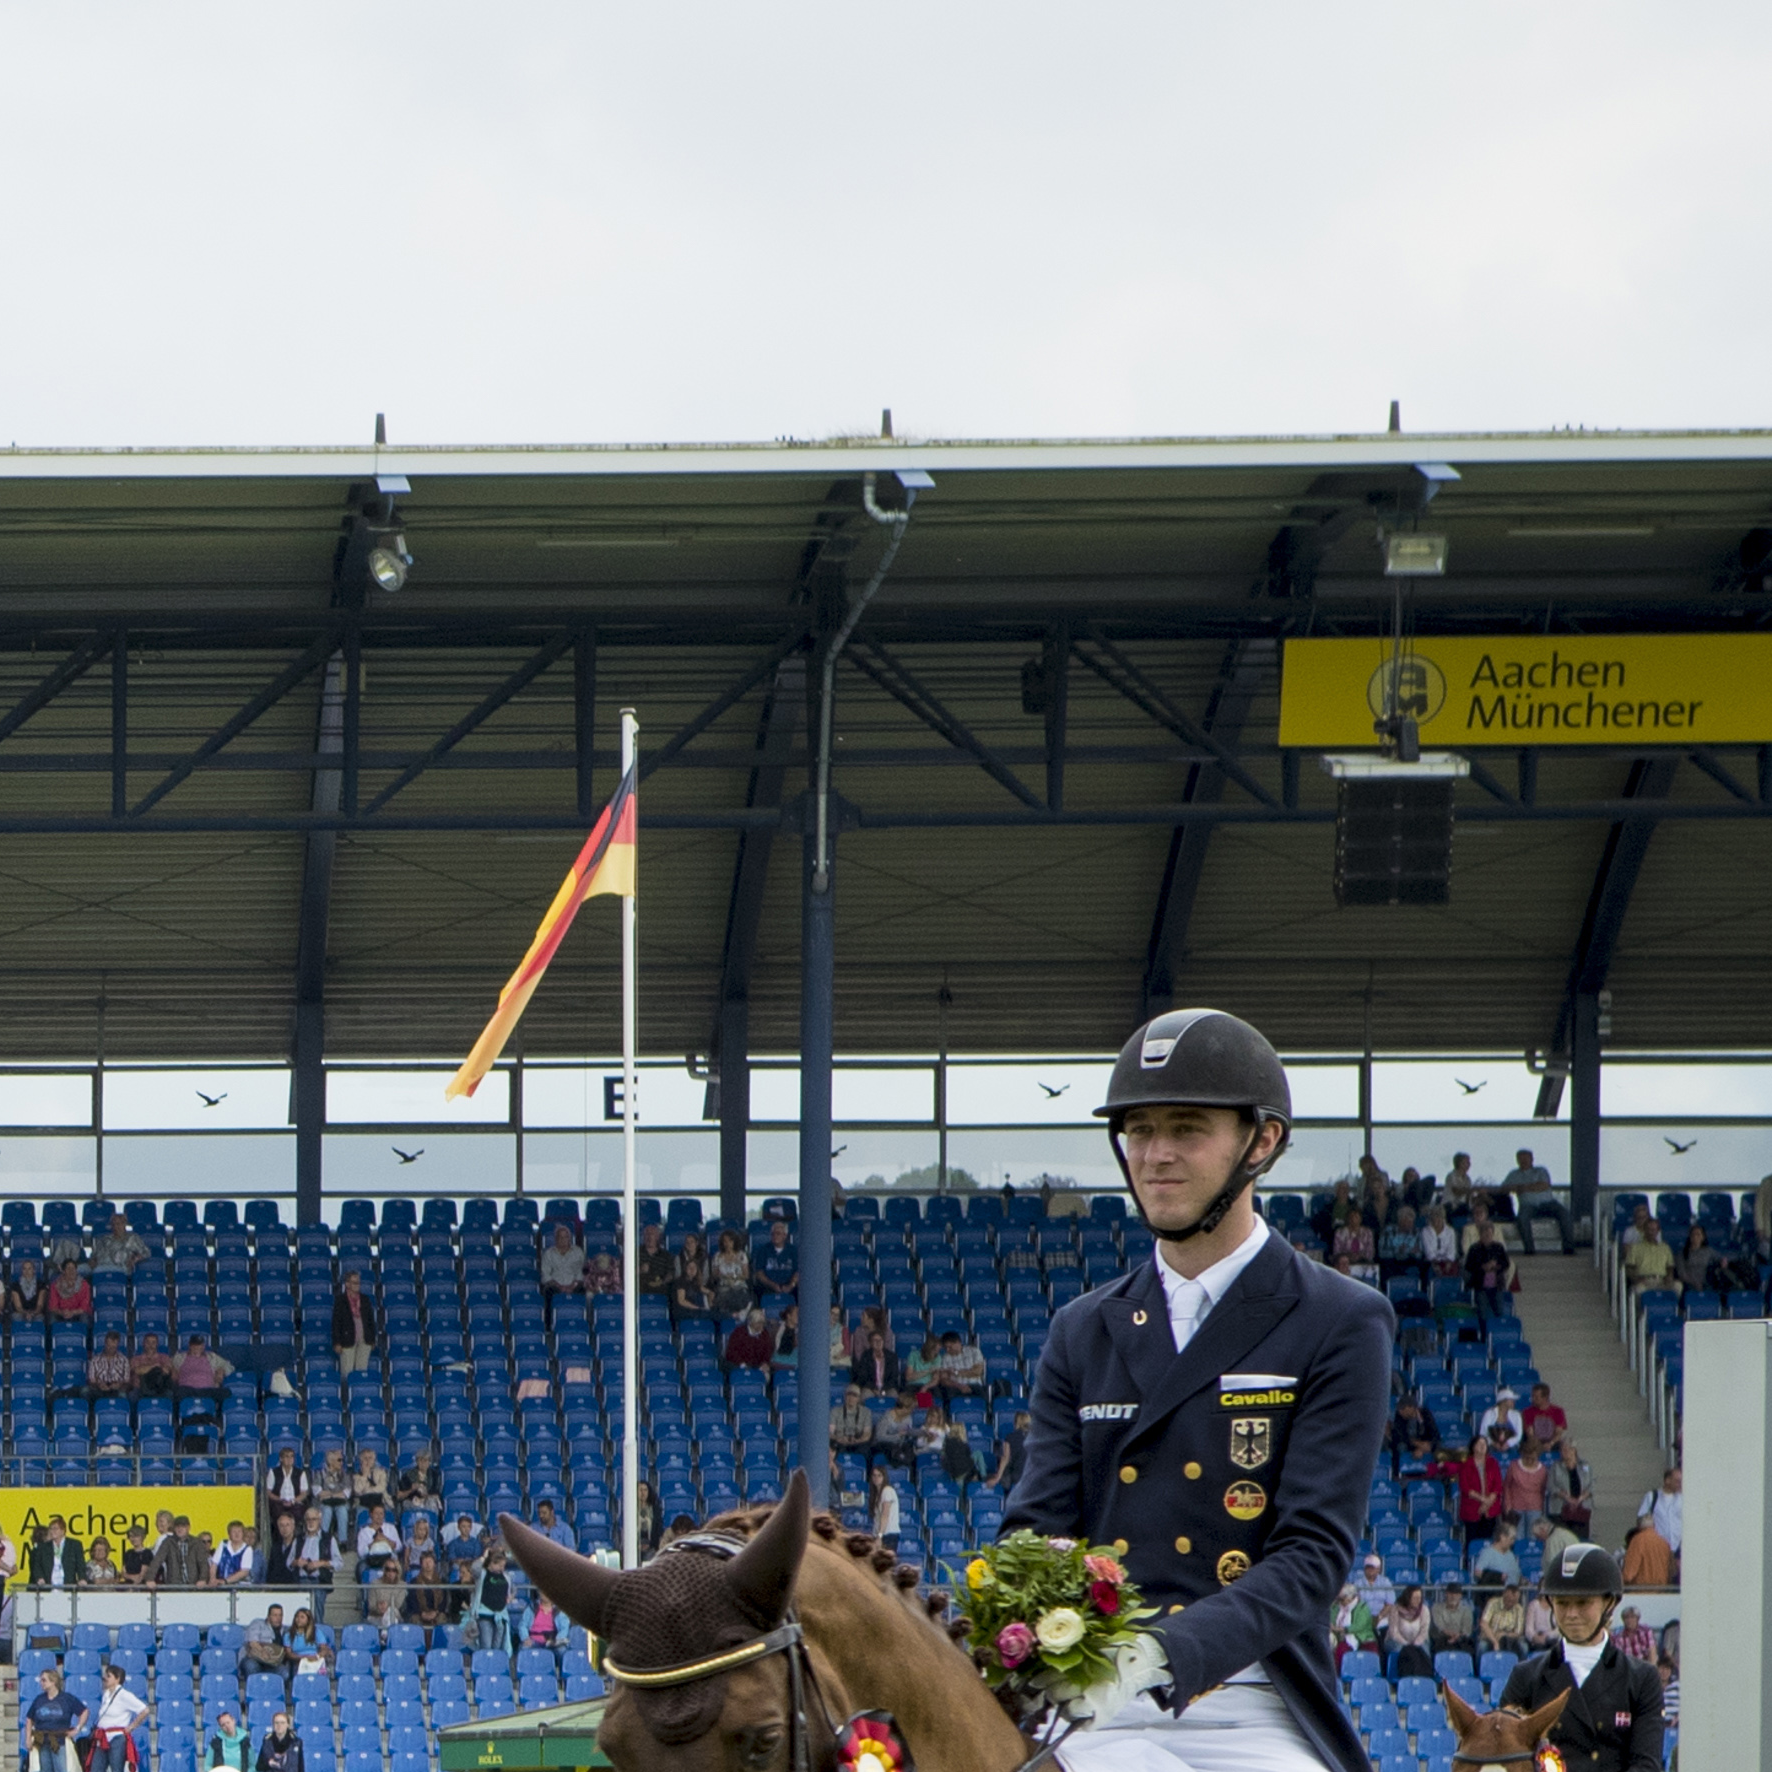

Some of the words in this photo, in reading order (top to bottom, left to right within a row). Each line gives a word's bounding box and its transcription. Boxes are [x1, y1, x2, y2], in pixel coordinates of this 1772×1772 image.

[1469, 651, 1625, 689] Aachen
[1467, 692, 1703, 729] Münchener
[604, 1076, 638, 1120] E
[1220, 1390, 1295, 1407] Cavallo
